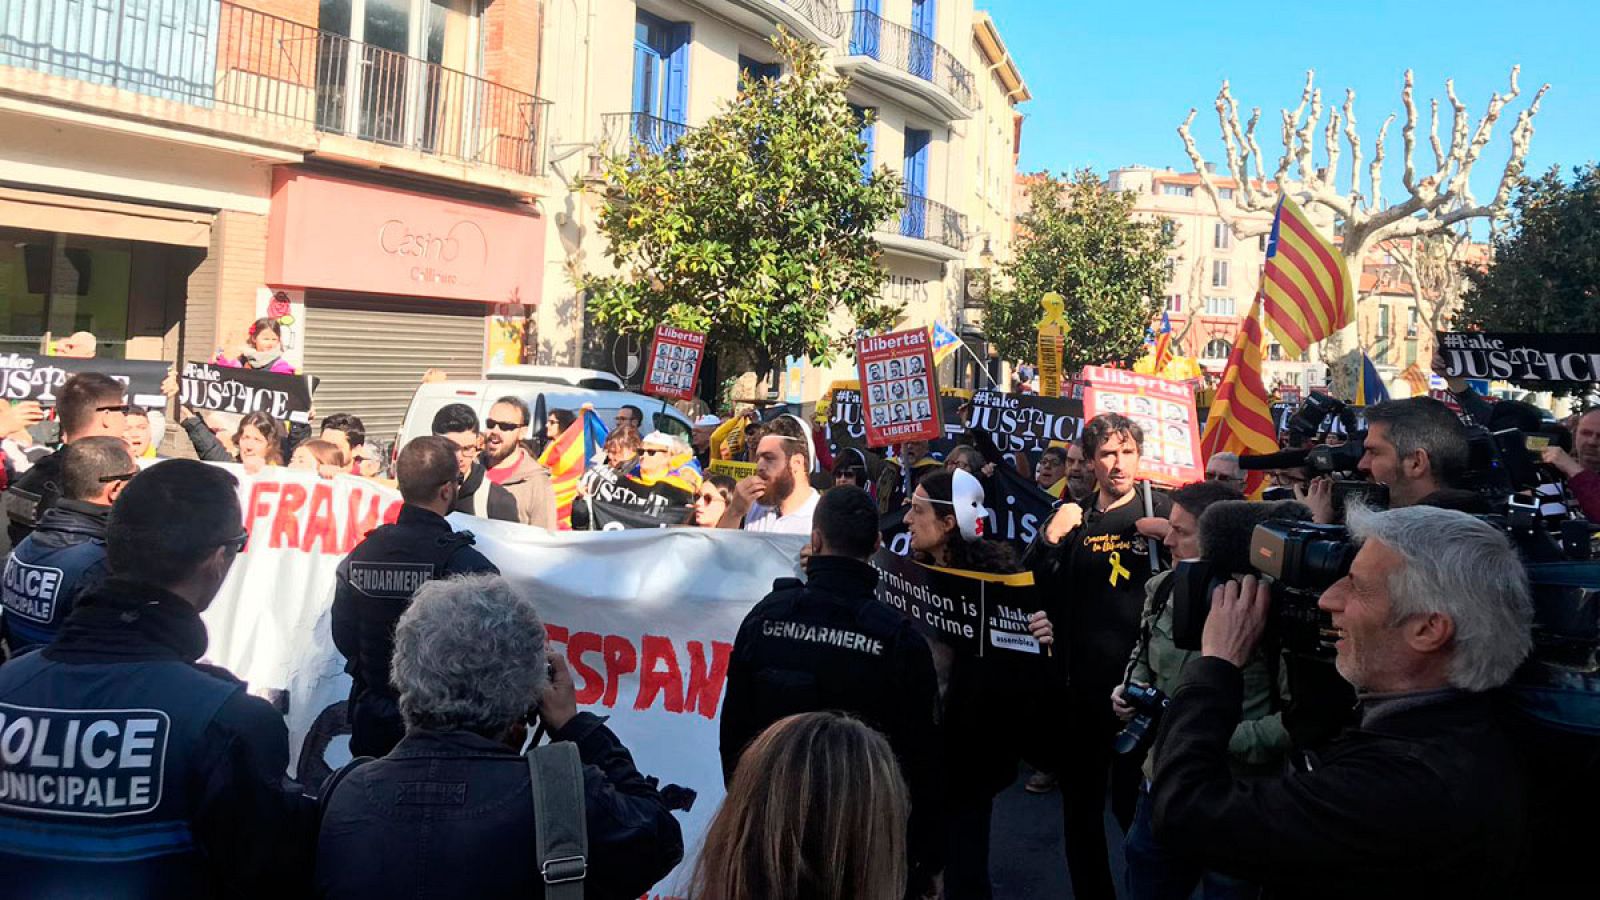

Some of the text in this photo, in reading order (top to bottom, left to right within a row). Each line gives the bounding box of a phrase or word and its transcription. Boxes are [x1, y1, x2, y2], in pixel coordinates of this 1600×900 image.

[881, 273, 929, 304] PLIERS
[658, 326, 705, 344] Llibertat
[860, 331, 926, 353] Llibertat
[1443, 333, 1505, 350] #Fake
[180, 377, 289, 420] JUSTICE
[835, 390, 862, 404] #Fa
[974, 390, 1020, 409] #Fake
[7, 559, 58, 600] OLICE
[351, 567, 432, 592] GENDARMERIE
[886, 589, 908, 612] not
[911, 604, 921, 619] a
[926, 611, 975, 639] crime
[961, 596, 978, 617] is
[762, 619, 884, 656] GENDARMERIE
[989, 615, 1029, 633] a mov
[544, 623, 734, 720] SPAN
[0, 712, 160, 770] OLICE
[0, 770, 151, 808] UNICIPALE
